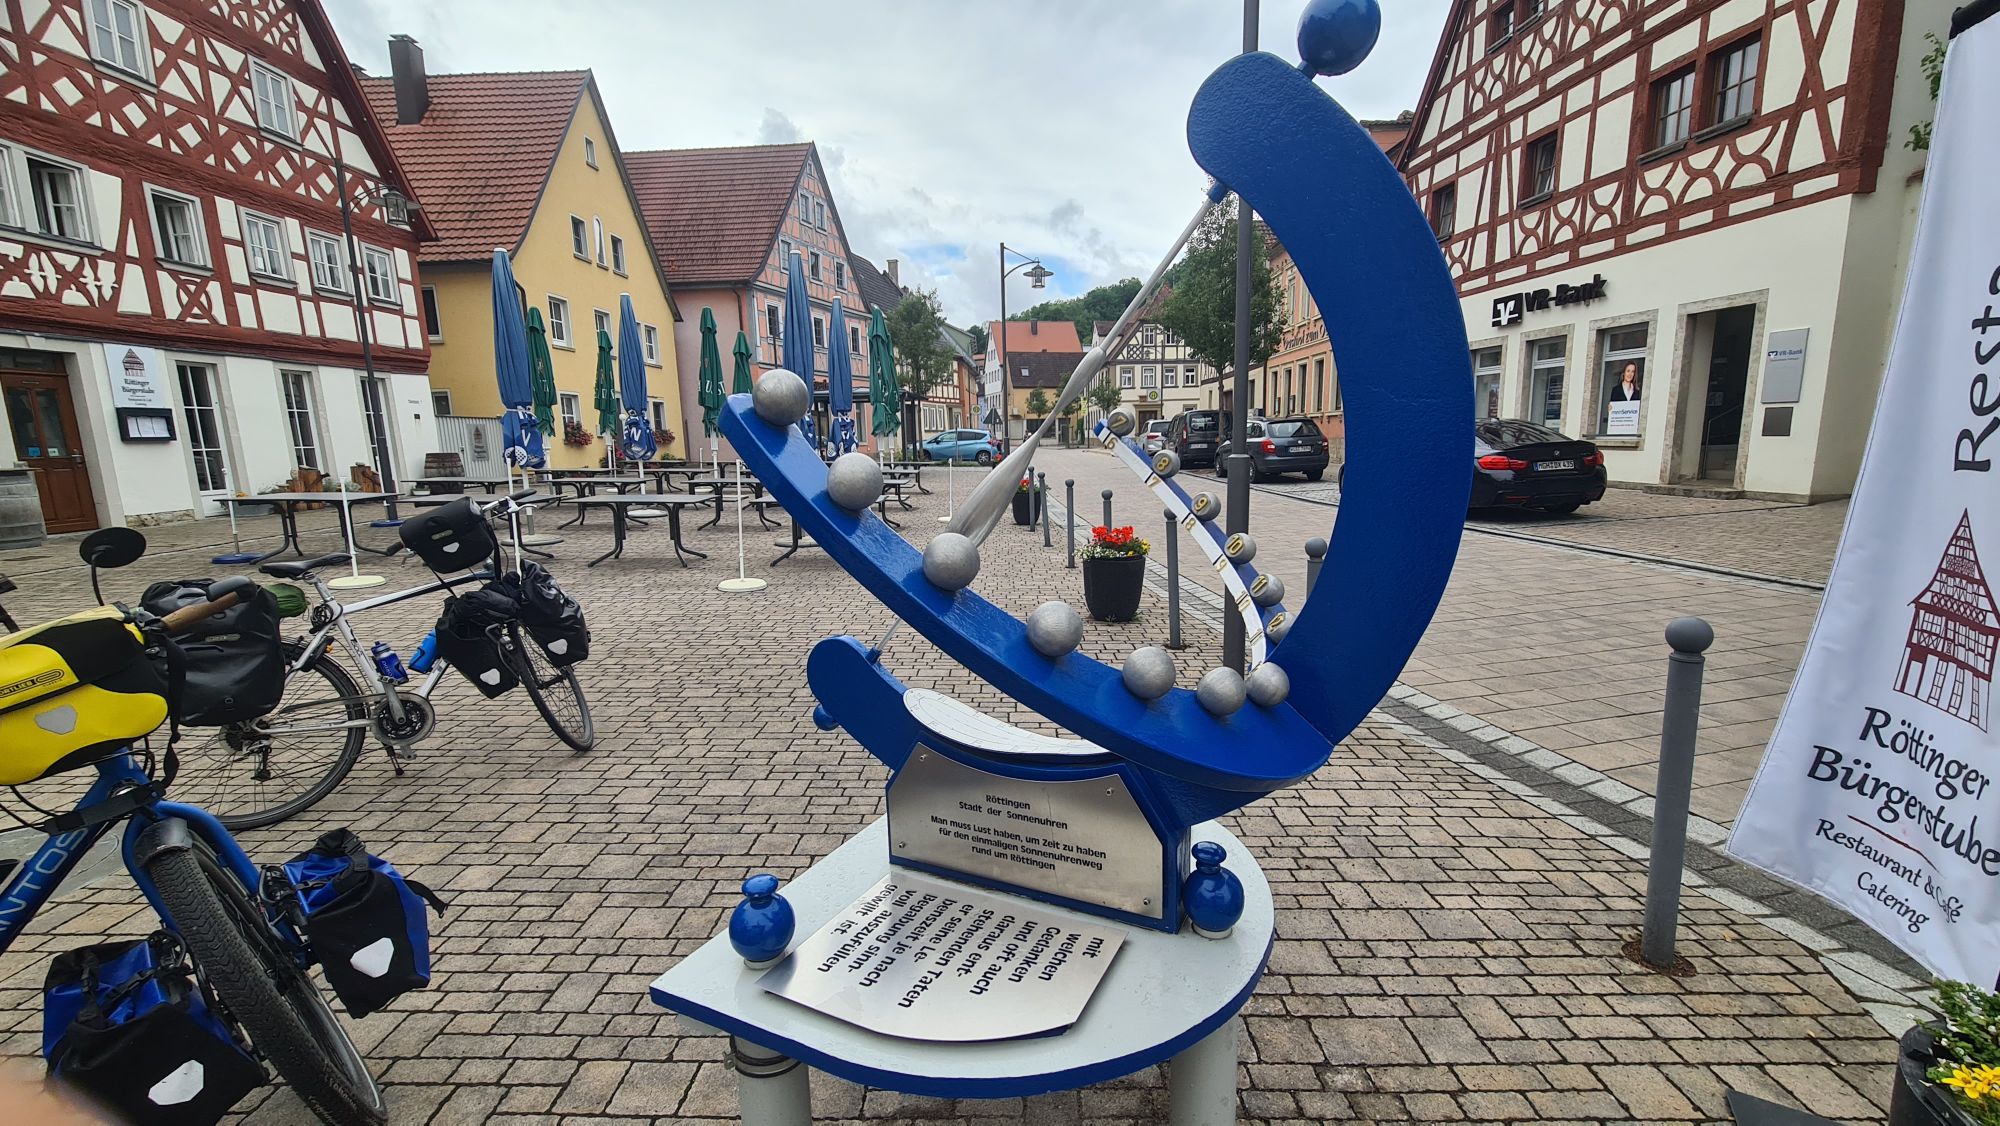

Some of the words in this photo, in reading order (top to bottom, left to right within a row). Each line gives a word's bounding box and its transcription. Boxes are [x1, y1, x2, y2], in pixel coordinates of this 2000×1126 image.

[1525, 274, 1607, 312] VR-Bank
[1112, 415, 1127, 428] 7
[1107, 437, 1118, 449] 6
[1157, 457, 1169, 471] 8
[1147, 476, 1161, 488] 7
[1194, 496, 1208, 512] 9
[1185, 517, 1196, 531] 8
[1226, 534, 1244, 556] 10
[1216, 559, 1227, 572] 9
[1859, 706, 1990, 800] Röttinger
[959, 801, 982, 813] Stadt
[987, 807, 1002, 816] der
[1007, 810, 1068, 830] Sonnenuhren
[986, 794, 1030, 810] Röttingen
[1807, 745, 2000, 876] Bürgerstube
[931, 815, 948, 825] Man
[950, 820, 971, 831] muss
[973, 824, 991, 835] Lust
[993, 828, 1023, 843] haben,
[1025, 836, 1040, 845] um
[1042, 839, 1060, 849] Zeit
[1063, 844, 1073, 852] zu
[1076, 845, 1106, 859] haben
[939, 827, 951, 837] für
[954, 831, 969, 841] den
[972, 835, 1018, 852] einmaligen
[1021, 845, 1103, 871] Sonnenuhrenweg
[972, 846, 992, 856] rund
[994, 851, 1008, 860] um
[1010, 853, 1056, 870] Röttingen
[1815, 818, 1923, 888] Restaurant
[1924, 876, 1936, 900] &
[0, 826, 89, 932] NTOS
[856, 883, 898, 917] gewillt
[892, 889, 917, 908] voll
[959, 904, 974, 916] er
[1857, 872, 1930, 933] Catering
[830, 919, 858, 935] ist.
[876, 893, 938, 944] Begabung
[905, 898, 958, 942] benszeit
[929, 916, 962, 944] seine
[977, 915, 1015, 951] daraus
[1013, 921, 1038, 942] und
[817, 909, 892, 973] auszufüllen
[892, 941, 912, 955] je
[935, 909, 995, 967] stehenden
[1082, 937, 1105, 959] mit
[848, 944, 880, 973] sinn-
[914, 945, 936, 963] Le-
[956, 952, 982, 977] ent-
[996, 943, 1019, 963] oft
[1008, 926, 1061, 983] Gedanken
[1038, 933, 1081, 981] welchen
[859, 956, 896, 987] nach
[969, 964, 1002, 995] auch
[898, 970, 943, 1008] Taten
